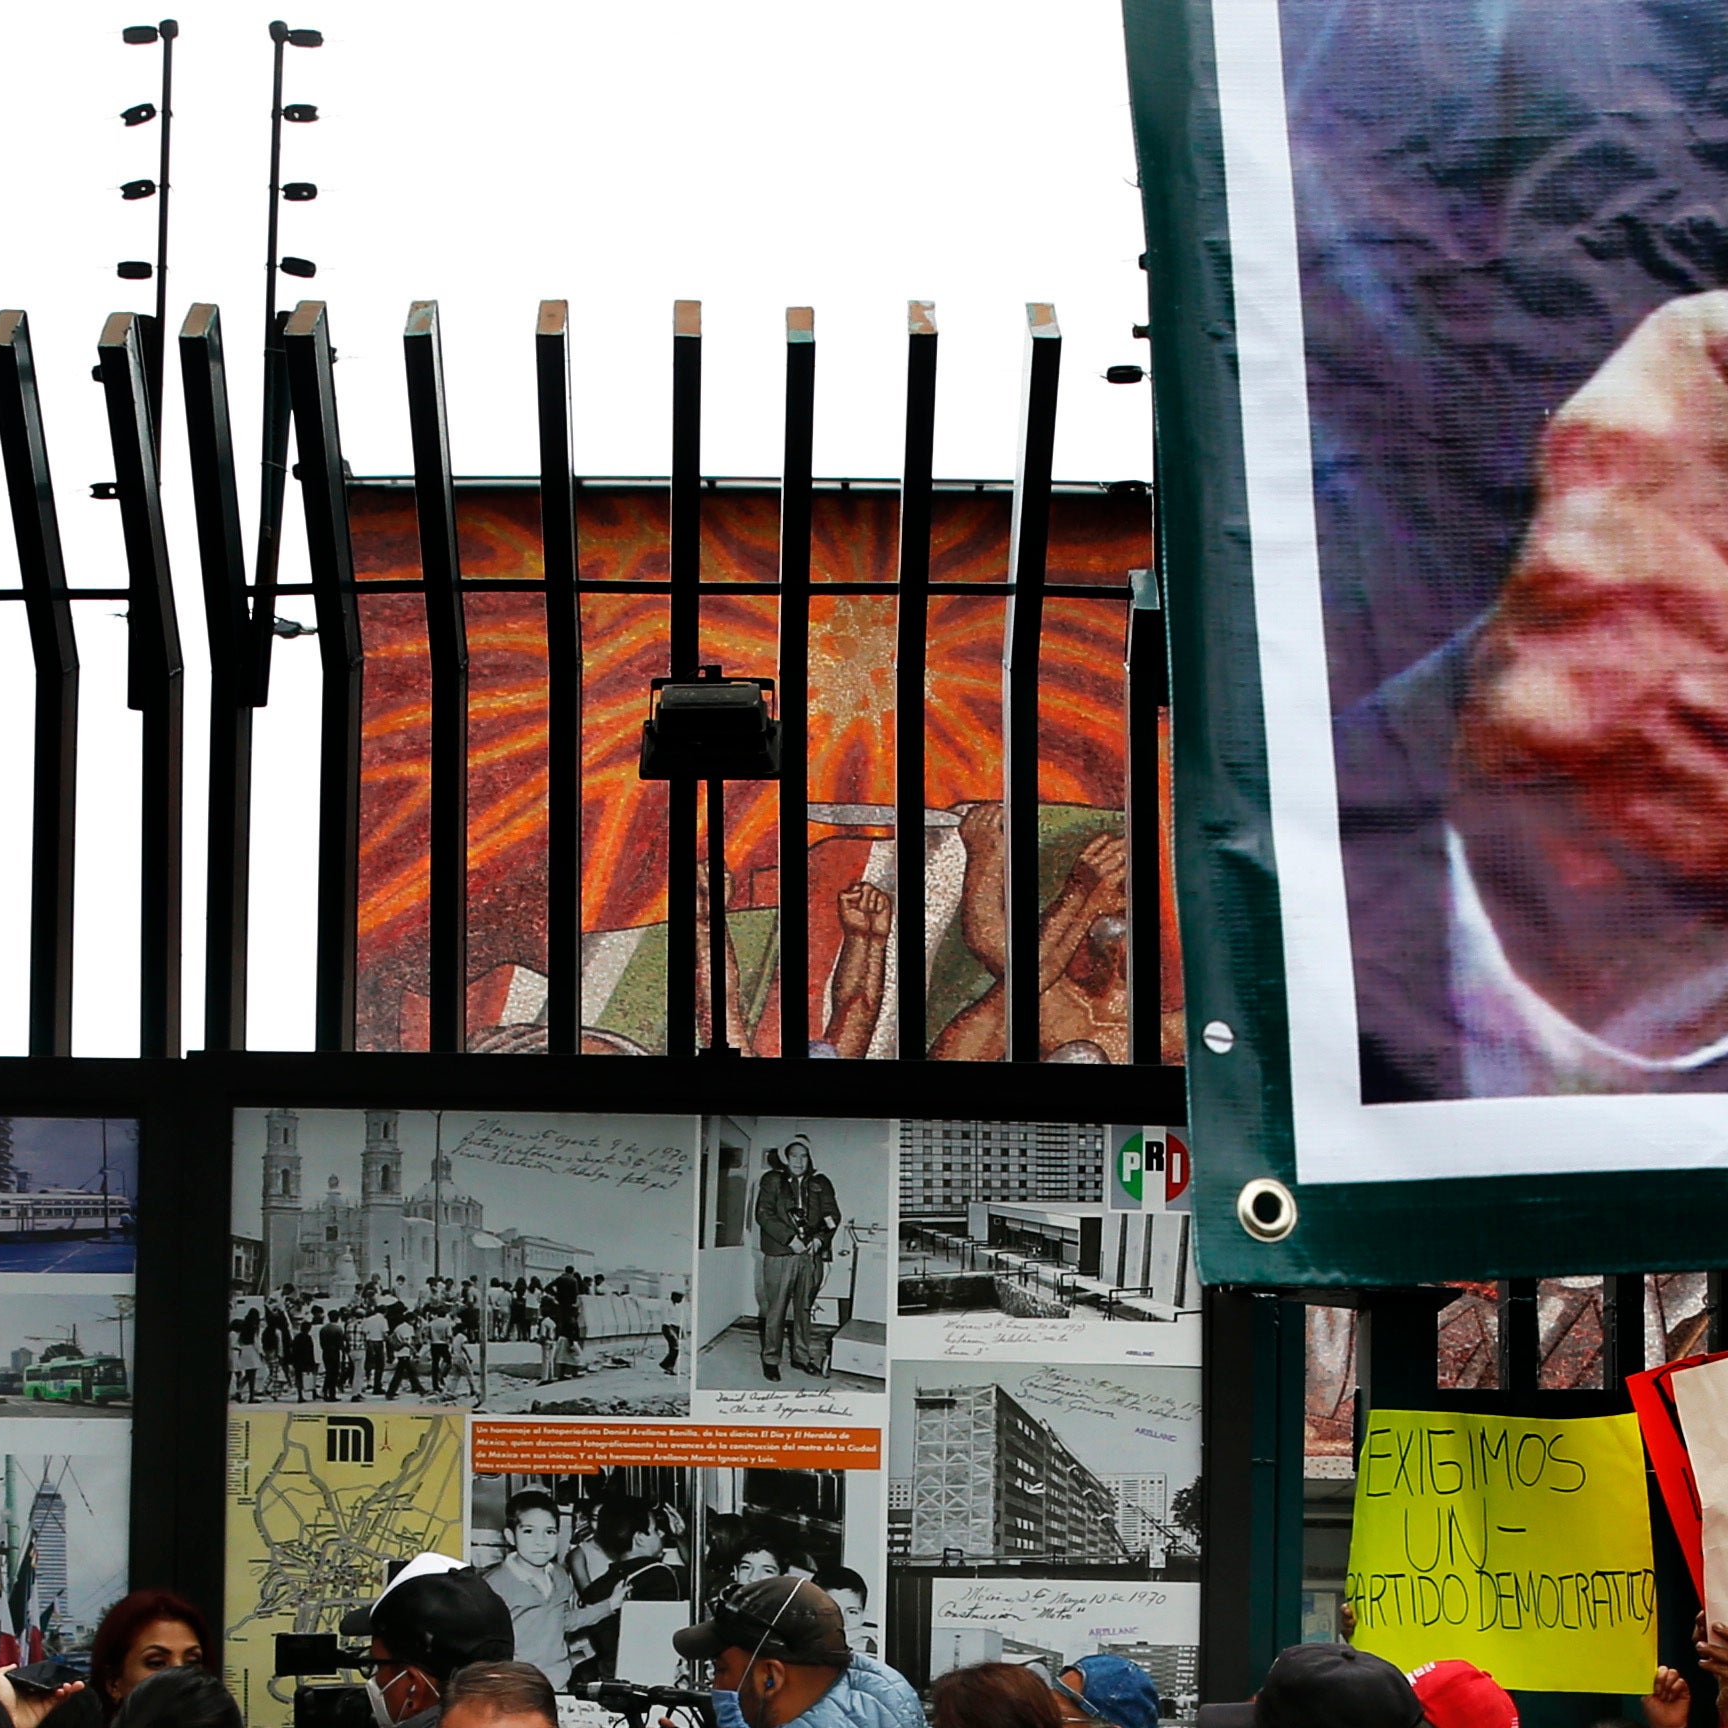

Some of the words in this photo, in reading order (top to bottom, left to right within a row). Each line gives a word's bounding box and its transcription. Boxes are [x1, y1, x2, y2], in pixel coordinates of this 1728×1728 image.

[1124, 1140, 1181, 1184] PRI
[1367, 1426, 1586, 1497] EXIGIMOS
[1346, 1572, 1469, 1629] PARTIDO
